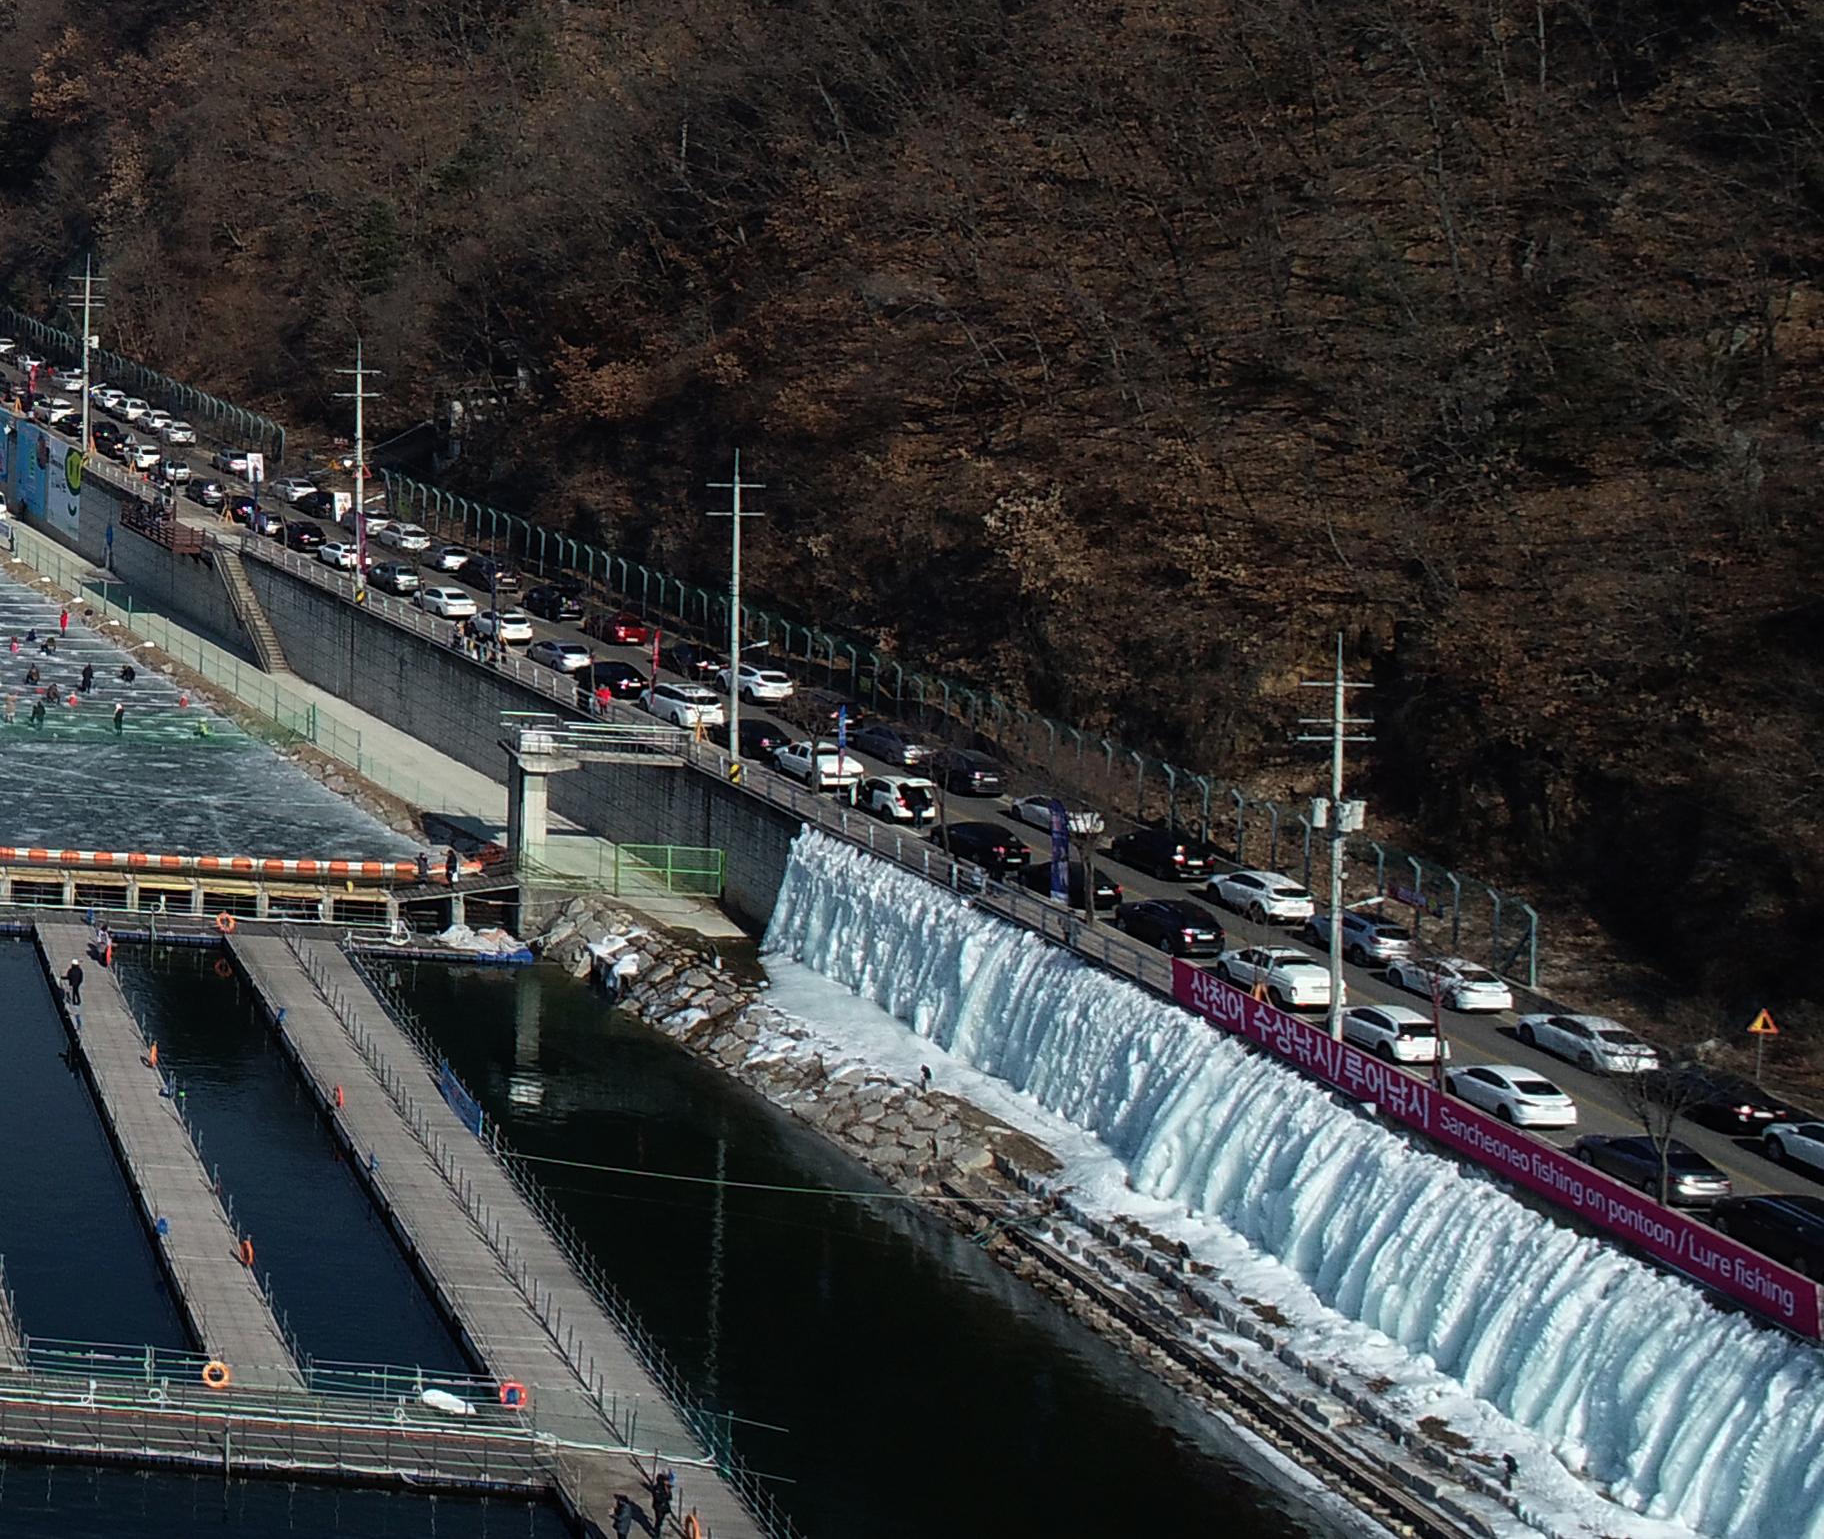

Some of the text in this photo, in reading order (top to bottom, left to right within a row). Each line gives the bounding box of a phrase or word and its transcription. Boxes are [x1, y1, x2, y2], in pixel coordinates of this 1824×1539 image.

[1190, 971, 1429, 1128] 산천어 수상낚시/루어낚시
[1440, 1106, 1529, 1172] Sancheoneo
[1532, 1154, 1583, 1206] fishing
[1586, 1188, 1605, 1212] on
[1734, 1260, 1794, 1317] fishing
